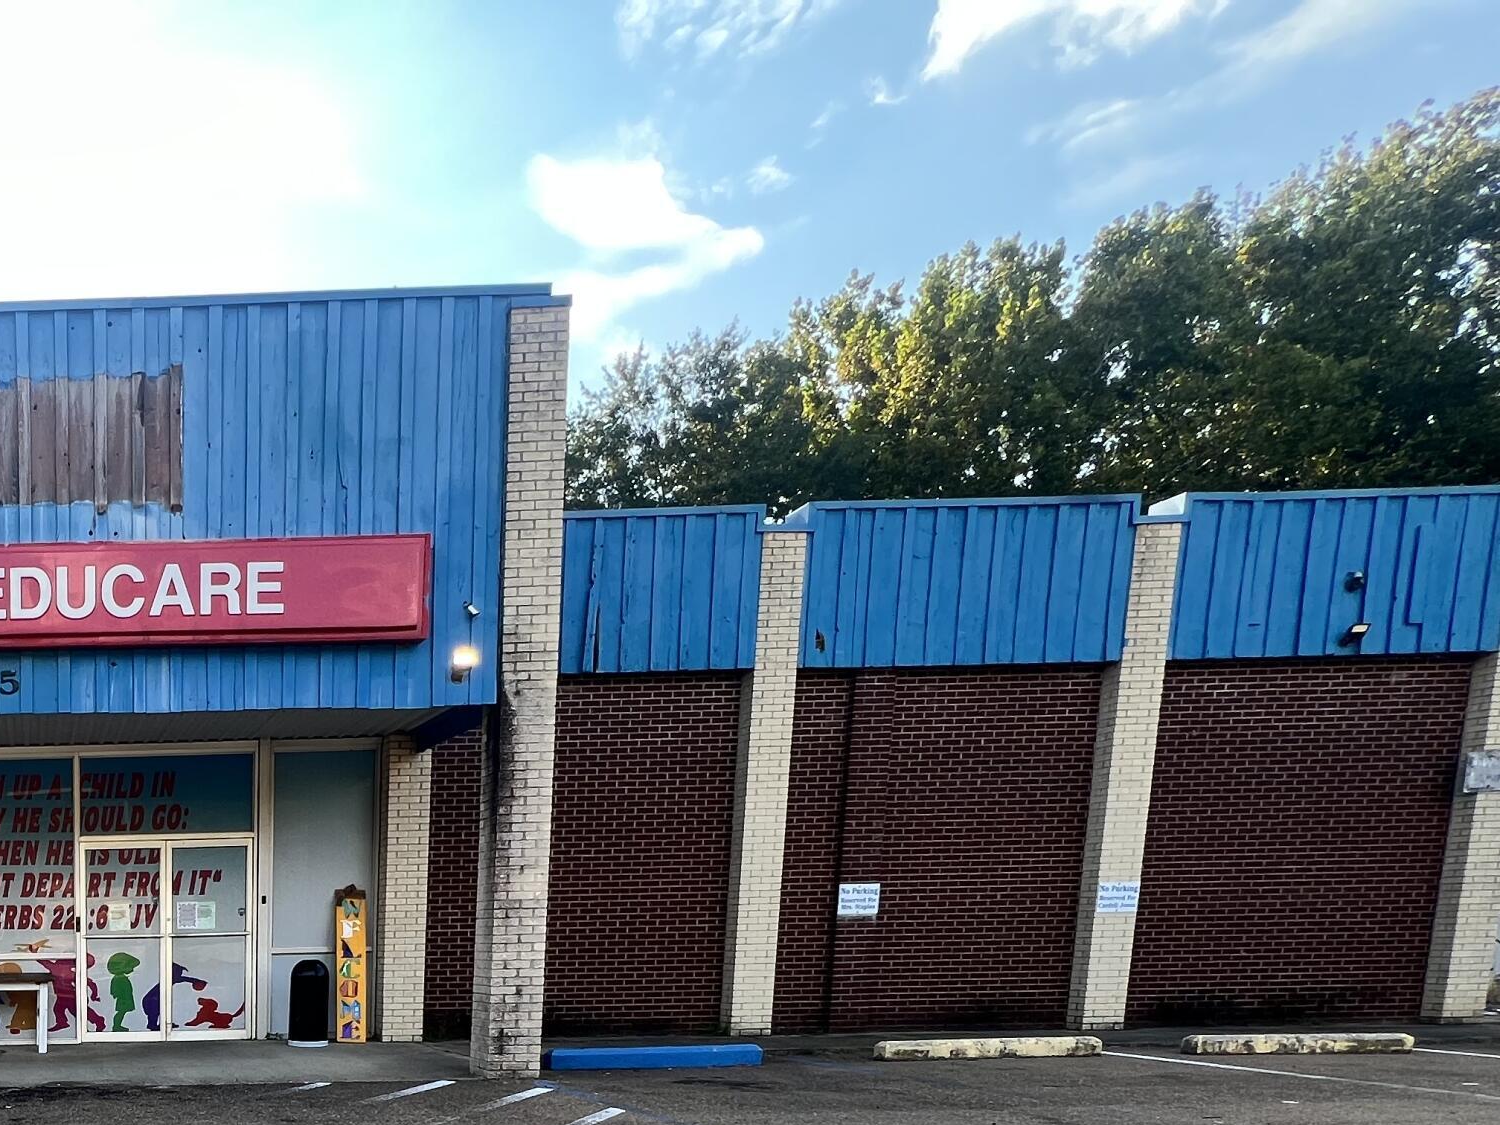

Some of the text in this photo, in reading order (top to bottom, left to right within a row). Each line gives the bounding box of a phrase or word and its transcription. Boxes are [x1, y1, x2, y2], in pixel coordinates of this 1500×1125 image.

[13, 773, 42, 800] UP
[47, 773, 62, 800] A
[80, 771, 145, 799] CHILD
[151, 771, 176, 797] IN
[11, 807, 43, 833] HE
[151, 803, 190, 831] GO:
